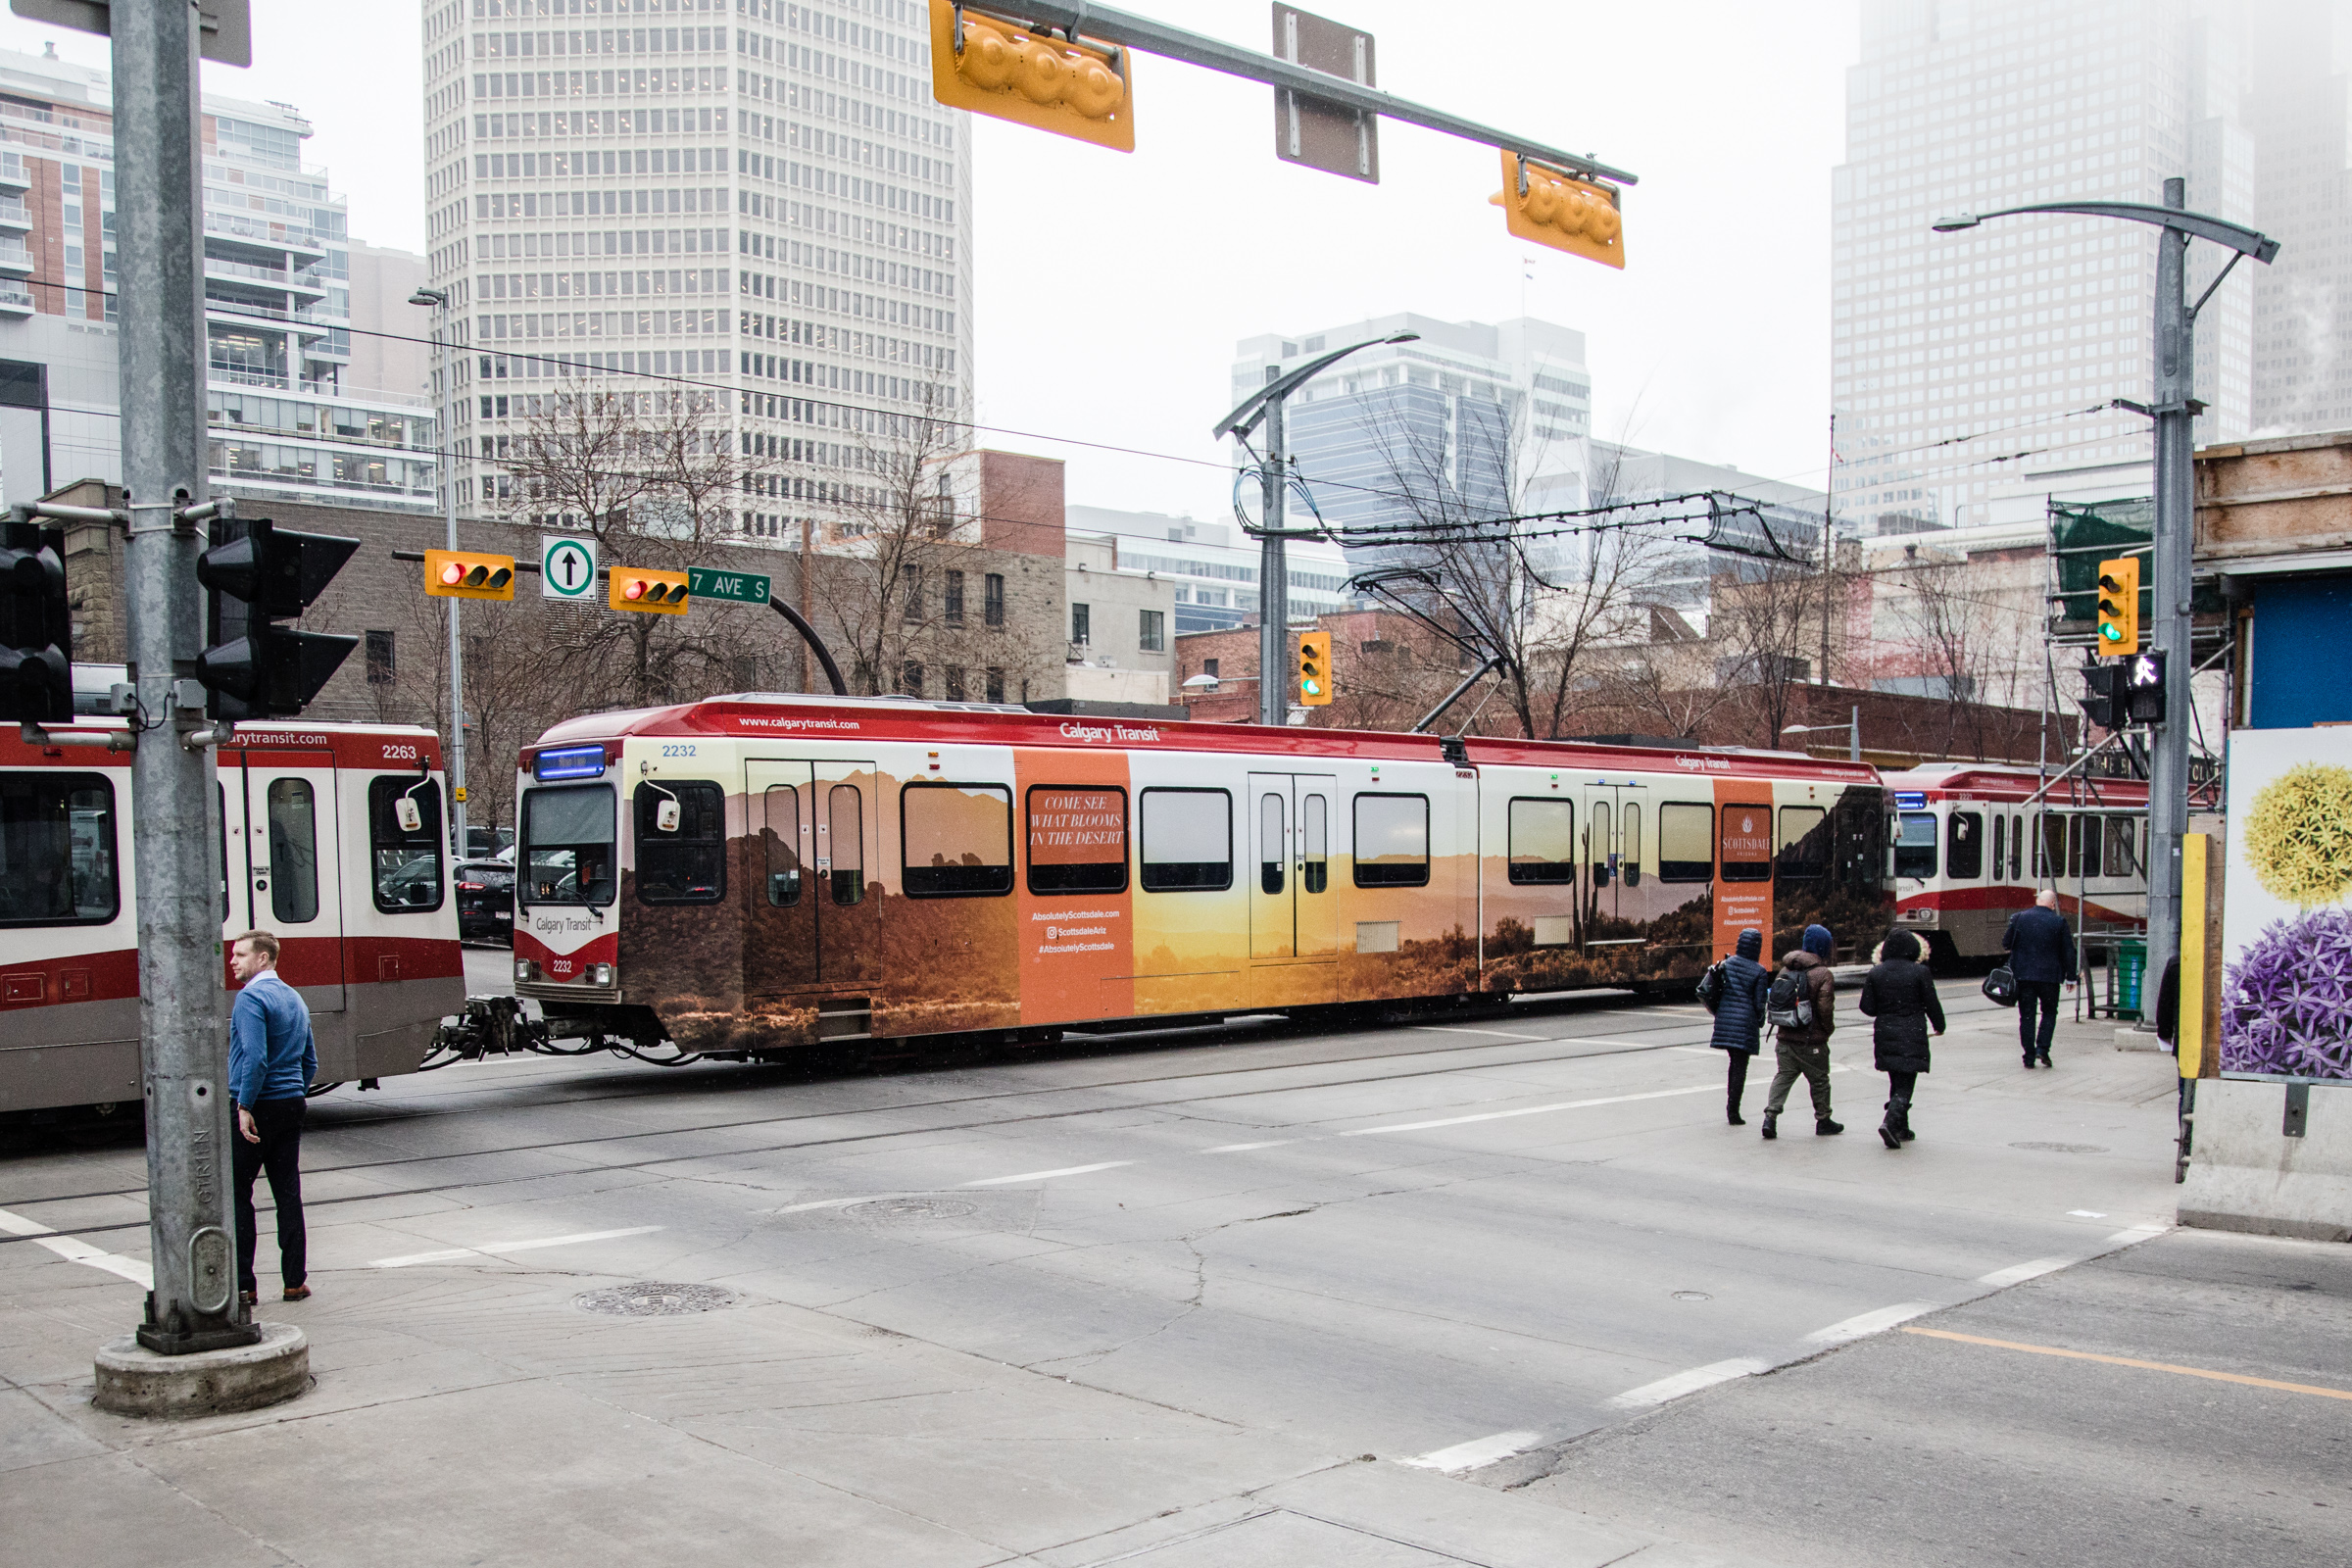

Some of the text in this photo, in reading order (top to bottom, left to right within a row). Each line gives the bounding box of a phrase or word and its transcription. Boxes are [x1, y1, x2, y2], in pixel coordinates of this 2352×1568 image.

[693, 573, 764, 598] 7 AVE S
[739, 716, 860, 730] www.calgarytransit.com
[229, 732, 327, 746] arytransit.com
[1059, 722, 1160, 743] Calgary Transit
[382, 745, 416, 759] 2263
[662, 745, 697, 757] 2232
[1675, 755, 1731, 770] Calgary Transit
[1045, 796, 1107, 809] COME SEE
[1031, 813, 1121, 828] WHAT BLOOMS
[1030, 831, 1124, 846] IN THE DESERT
[1032, 910, 1120, 921] AbsolutelyScottsdale.com
[536, 917, 591, 934] Calgary Transit
[1057, 926, 1106, 937] ScottsdaleAriz
[1039, 942, 1114, 954] #AbsolutelyScottsdale
[553, 960, 572, 973] 2232
